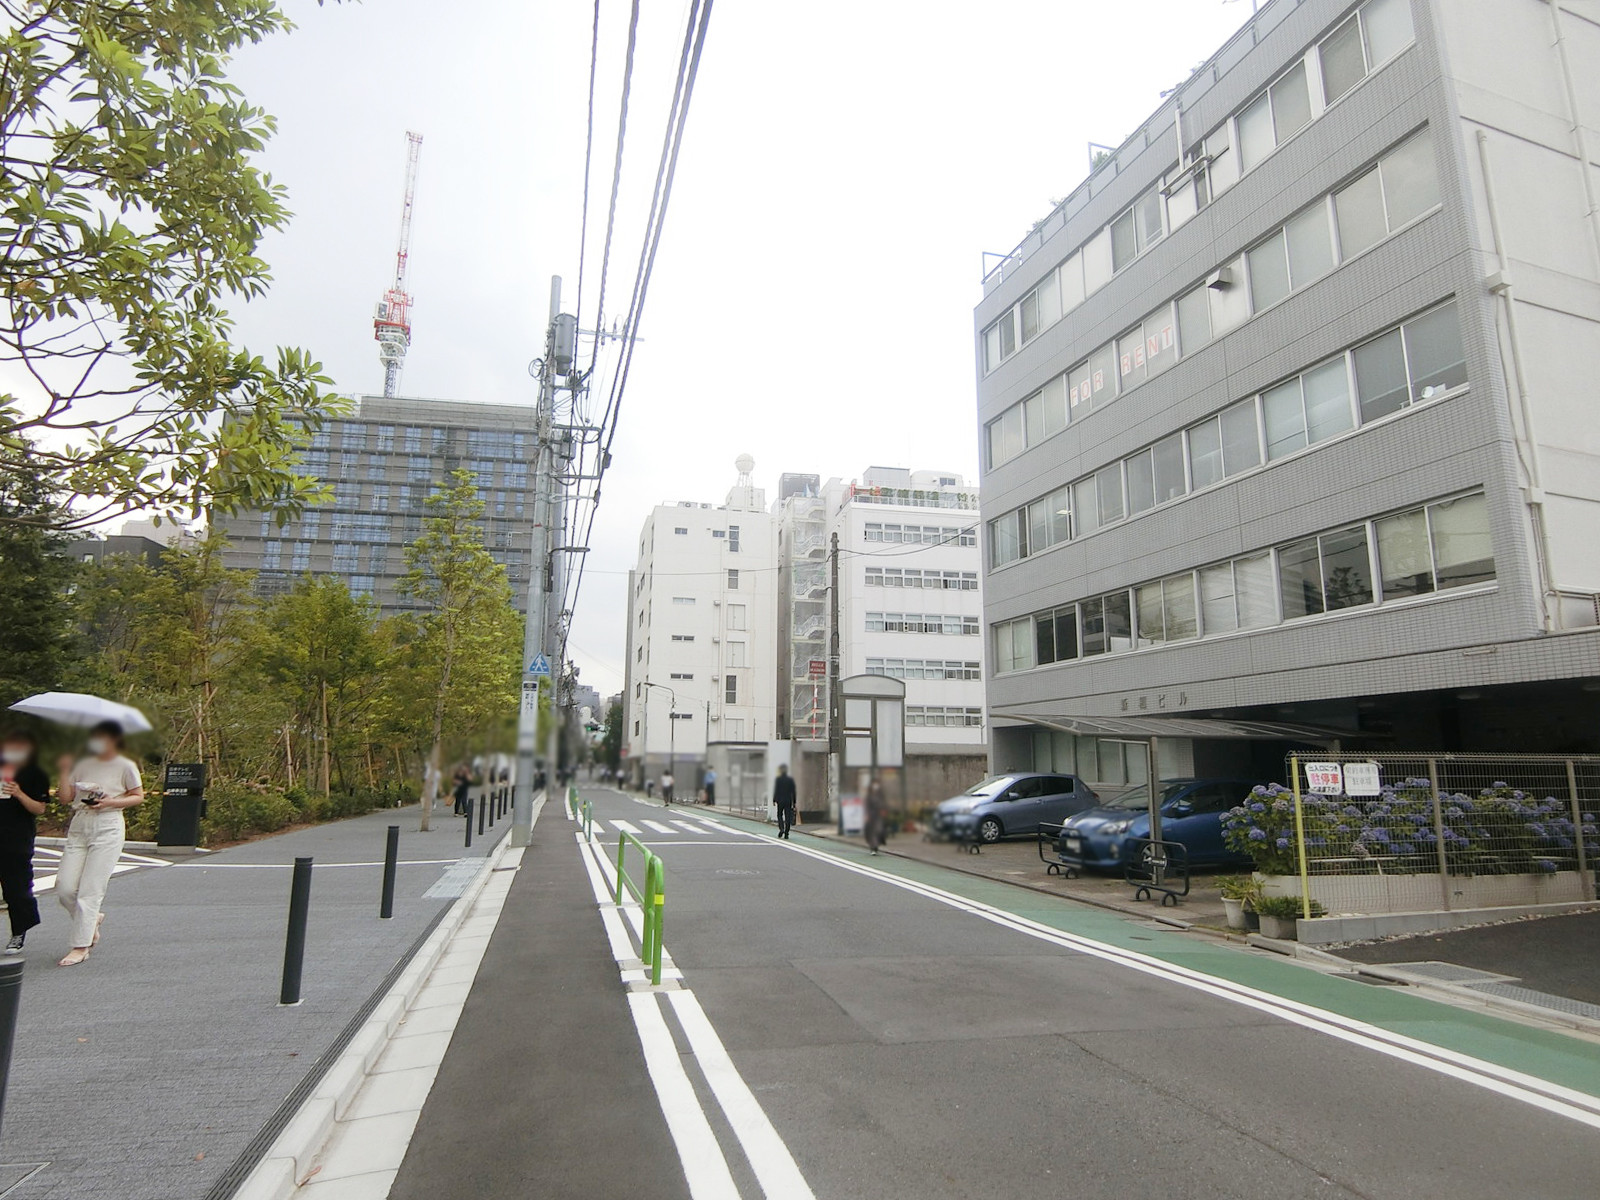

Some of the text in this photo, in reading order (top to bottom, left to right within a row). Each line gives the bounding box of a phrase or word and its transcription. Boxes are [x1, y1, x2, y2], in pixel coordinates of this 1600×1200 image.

[1070, 326, 1172, 407] FOR RENT
[1310, 773, 1340, 785] 駐停車
